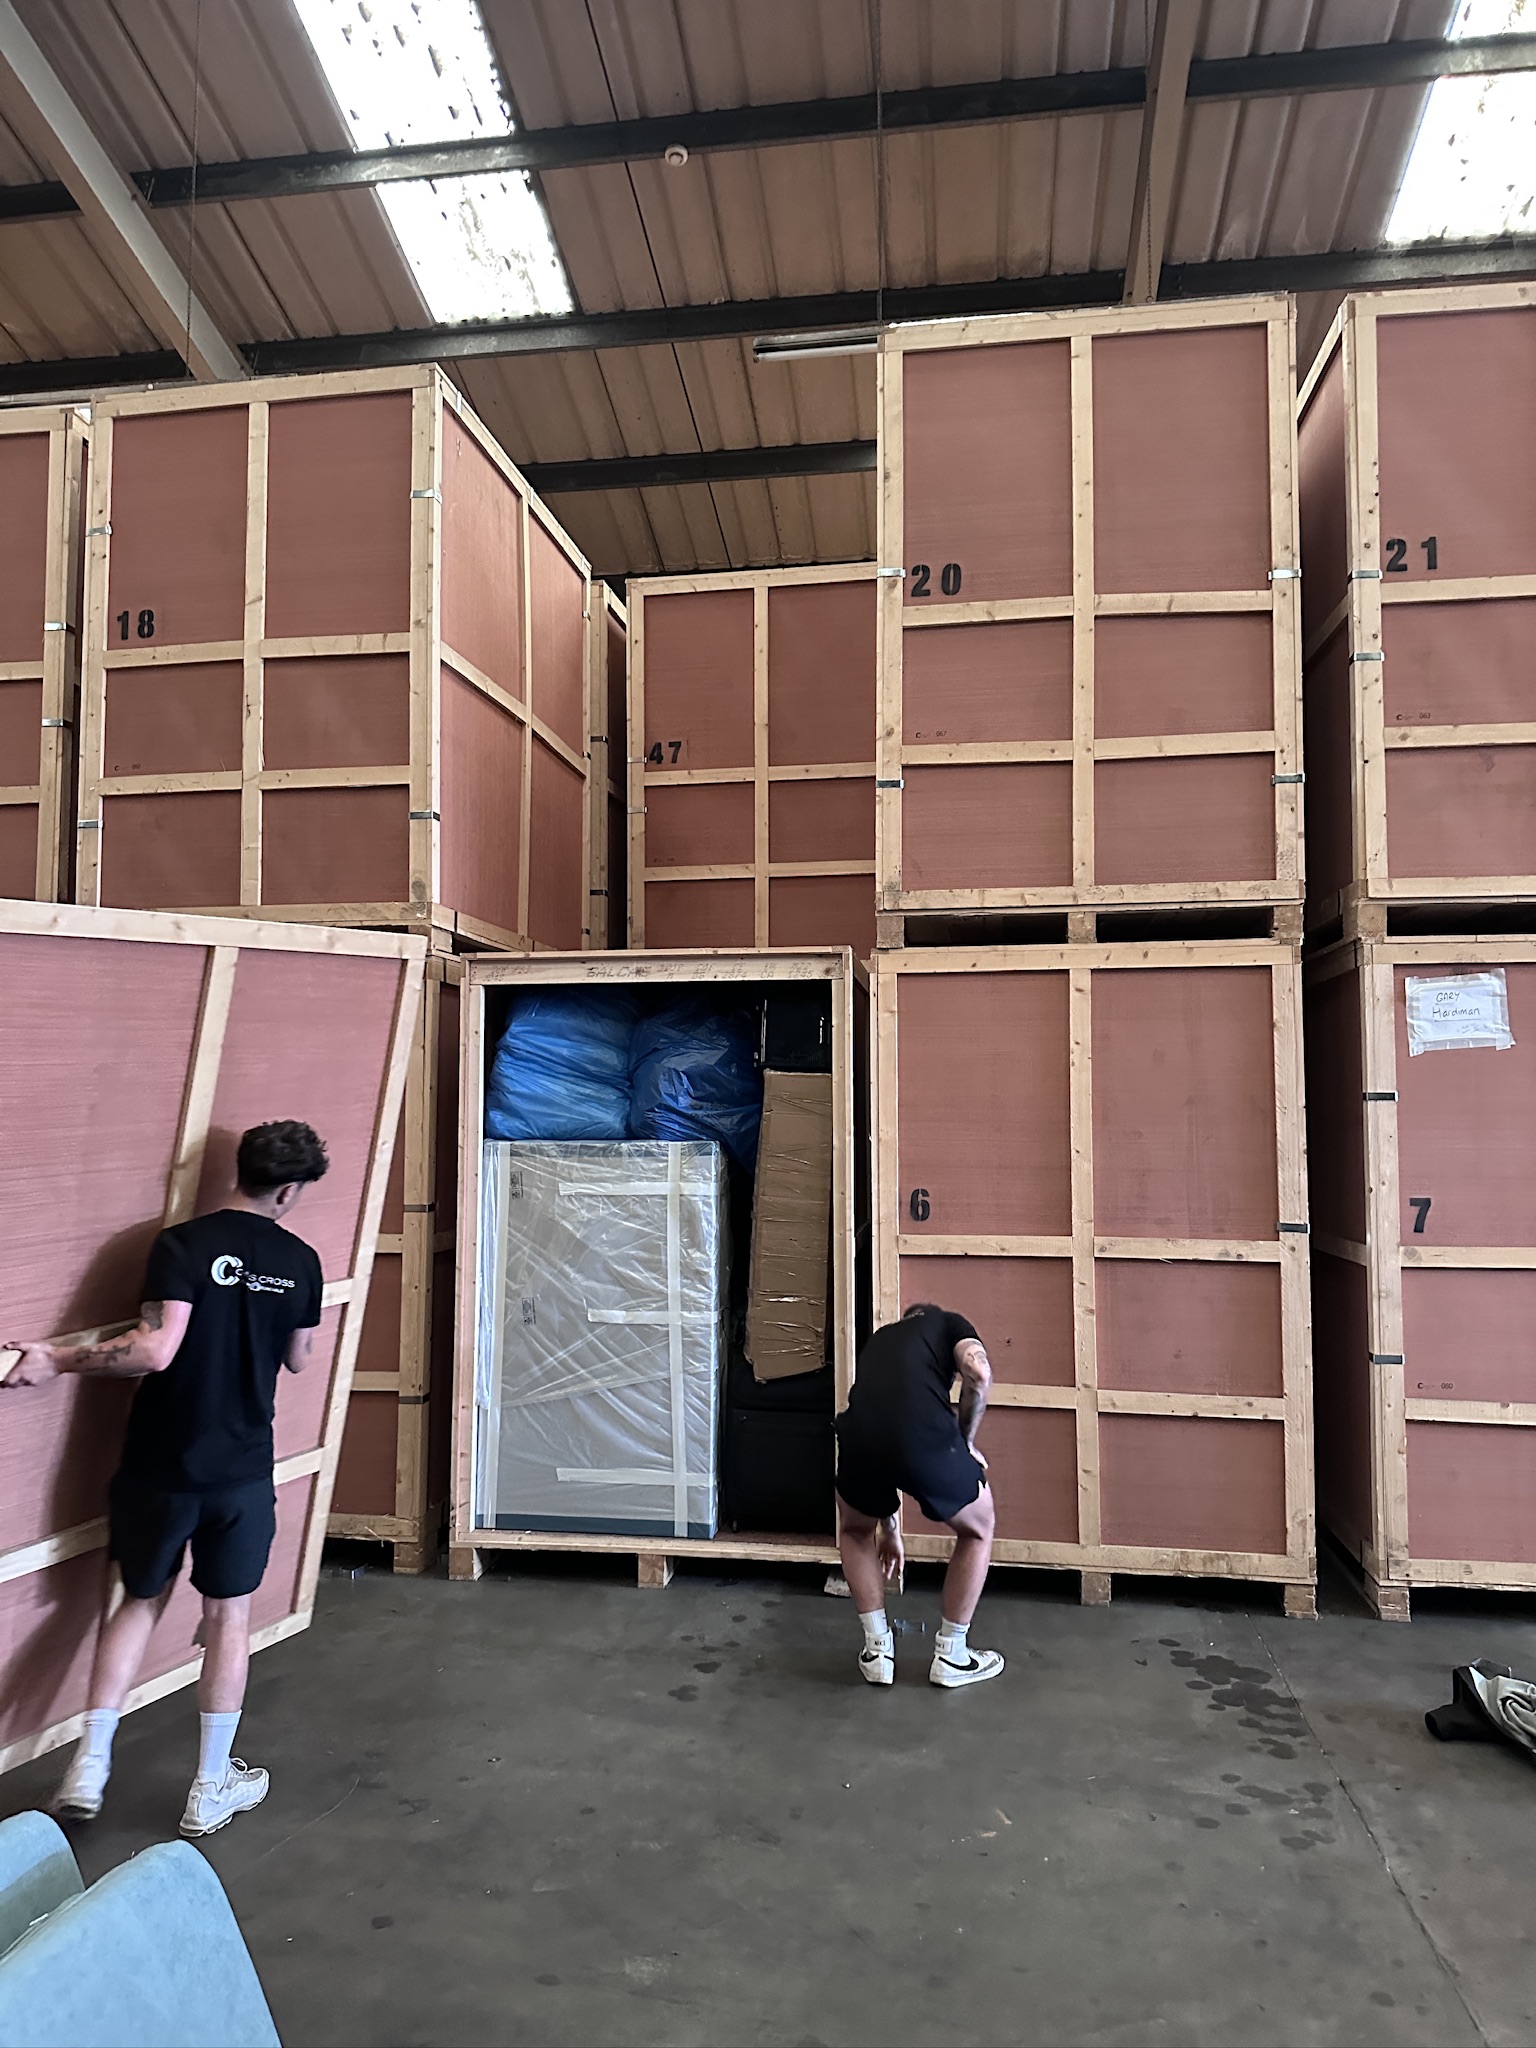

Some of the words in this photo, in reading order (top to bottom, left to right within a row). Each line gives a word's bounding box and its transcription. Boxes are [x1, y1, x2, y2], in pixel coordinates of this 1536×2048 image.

[1386, 536, 1438, 572] 21
[911, 563, 962, 597] 20
[117, 609, 154, 640] 18
[649, 741, 682, 764] 47
[1432, 1006, 1481, 1018] Hardiman
[1436, 991, 1460, 1003] GARY
[910, 1188, 930, 1222] 6
[1409, 1197, 1432, 1233] 7
[258, 1275, 296, 1288] CROSS
